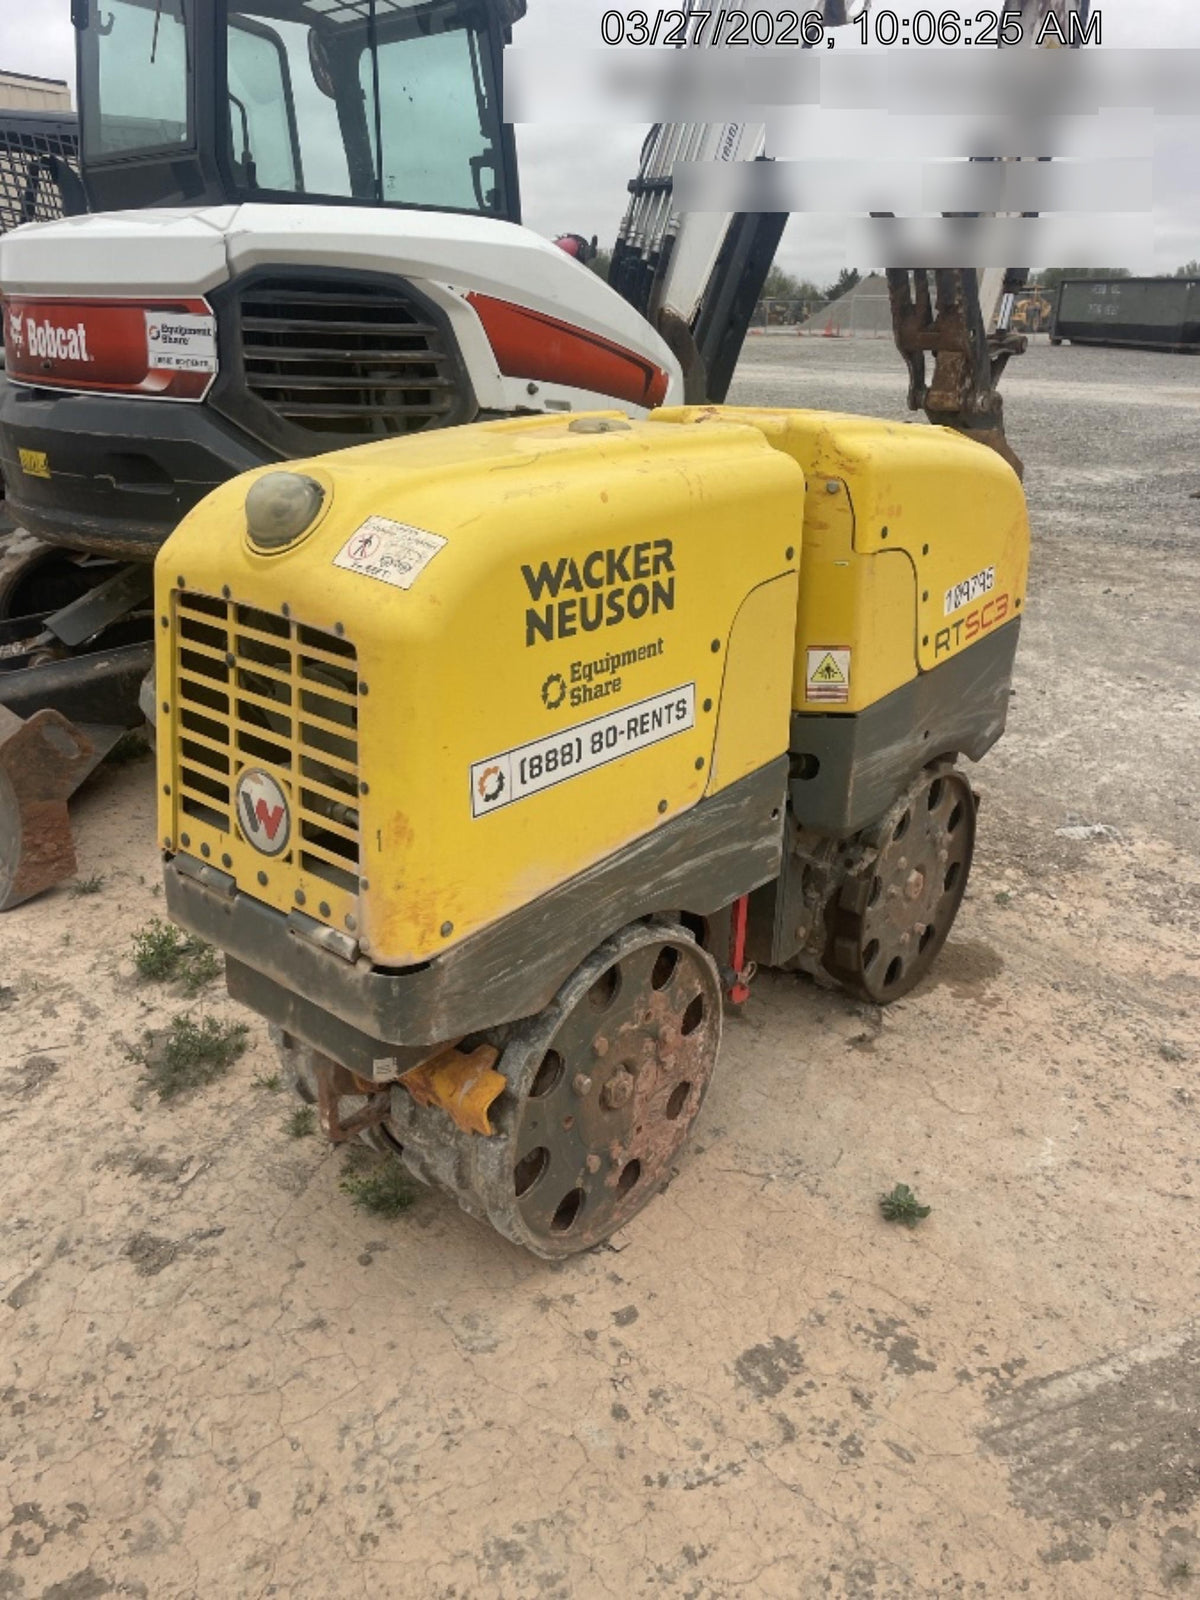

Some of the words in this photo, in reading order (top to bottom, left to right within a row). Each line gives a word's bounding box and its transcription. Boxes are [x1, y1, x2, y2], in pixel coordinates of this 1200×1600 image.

[26, 318, 88, 361] Bobcat
[161, 323, 212, 337] Equipment
[520, 538, 676, 602] WACKER
[525, 576, 676, 648] NEUSON
[569, 637, 664, 684] Equipment
[569, 676, 622, 708] Share
[520, 737, 582, 785] (888)
[590, 697, 688, 755] 80-RENTS
